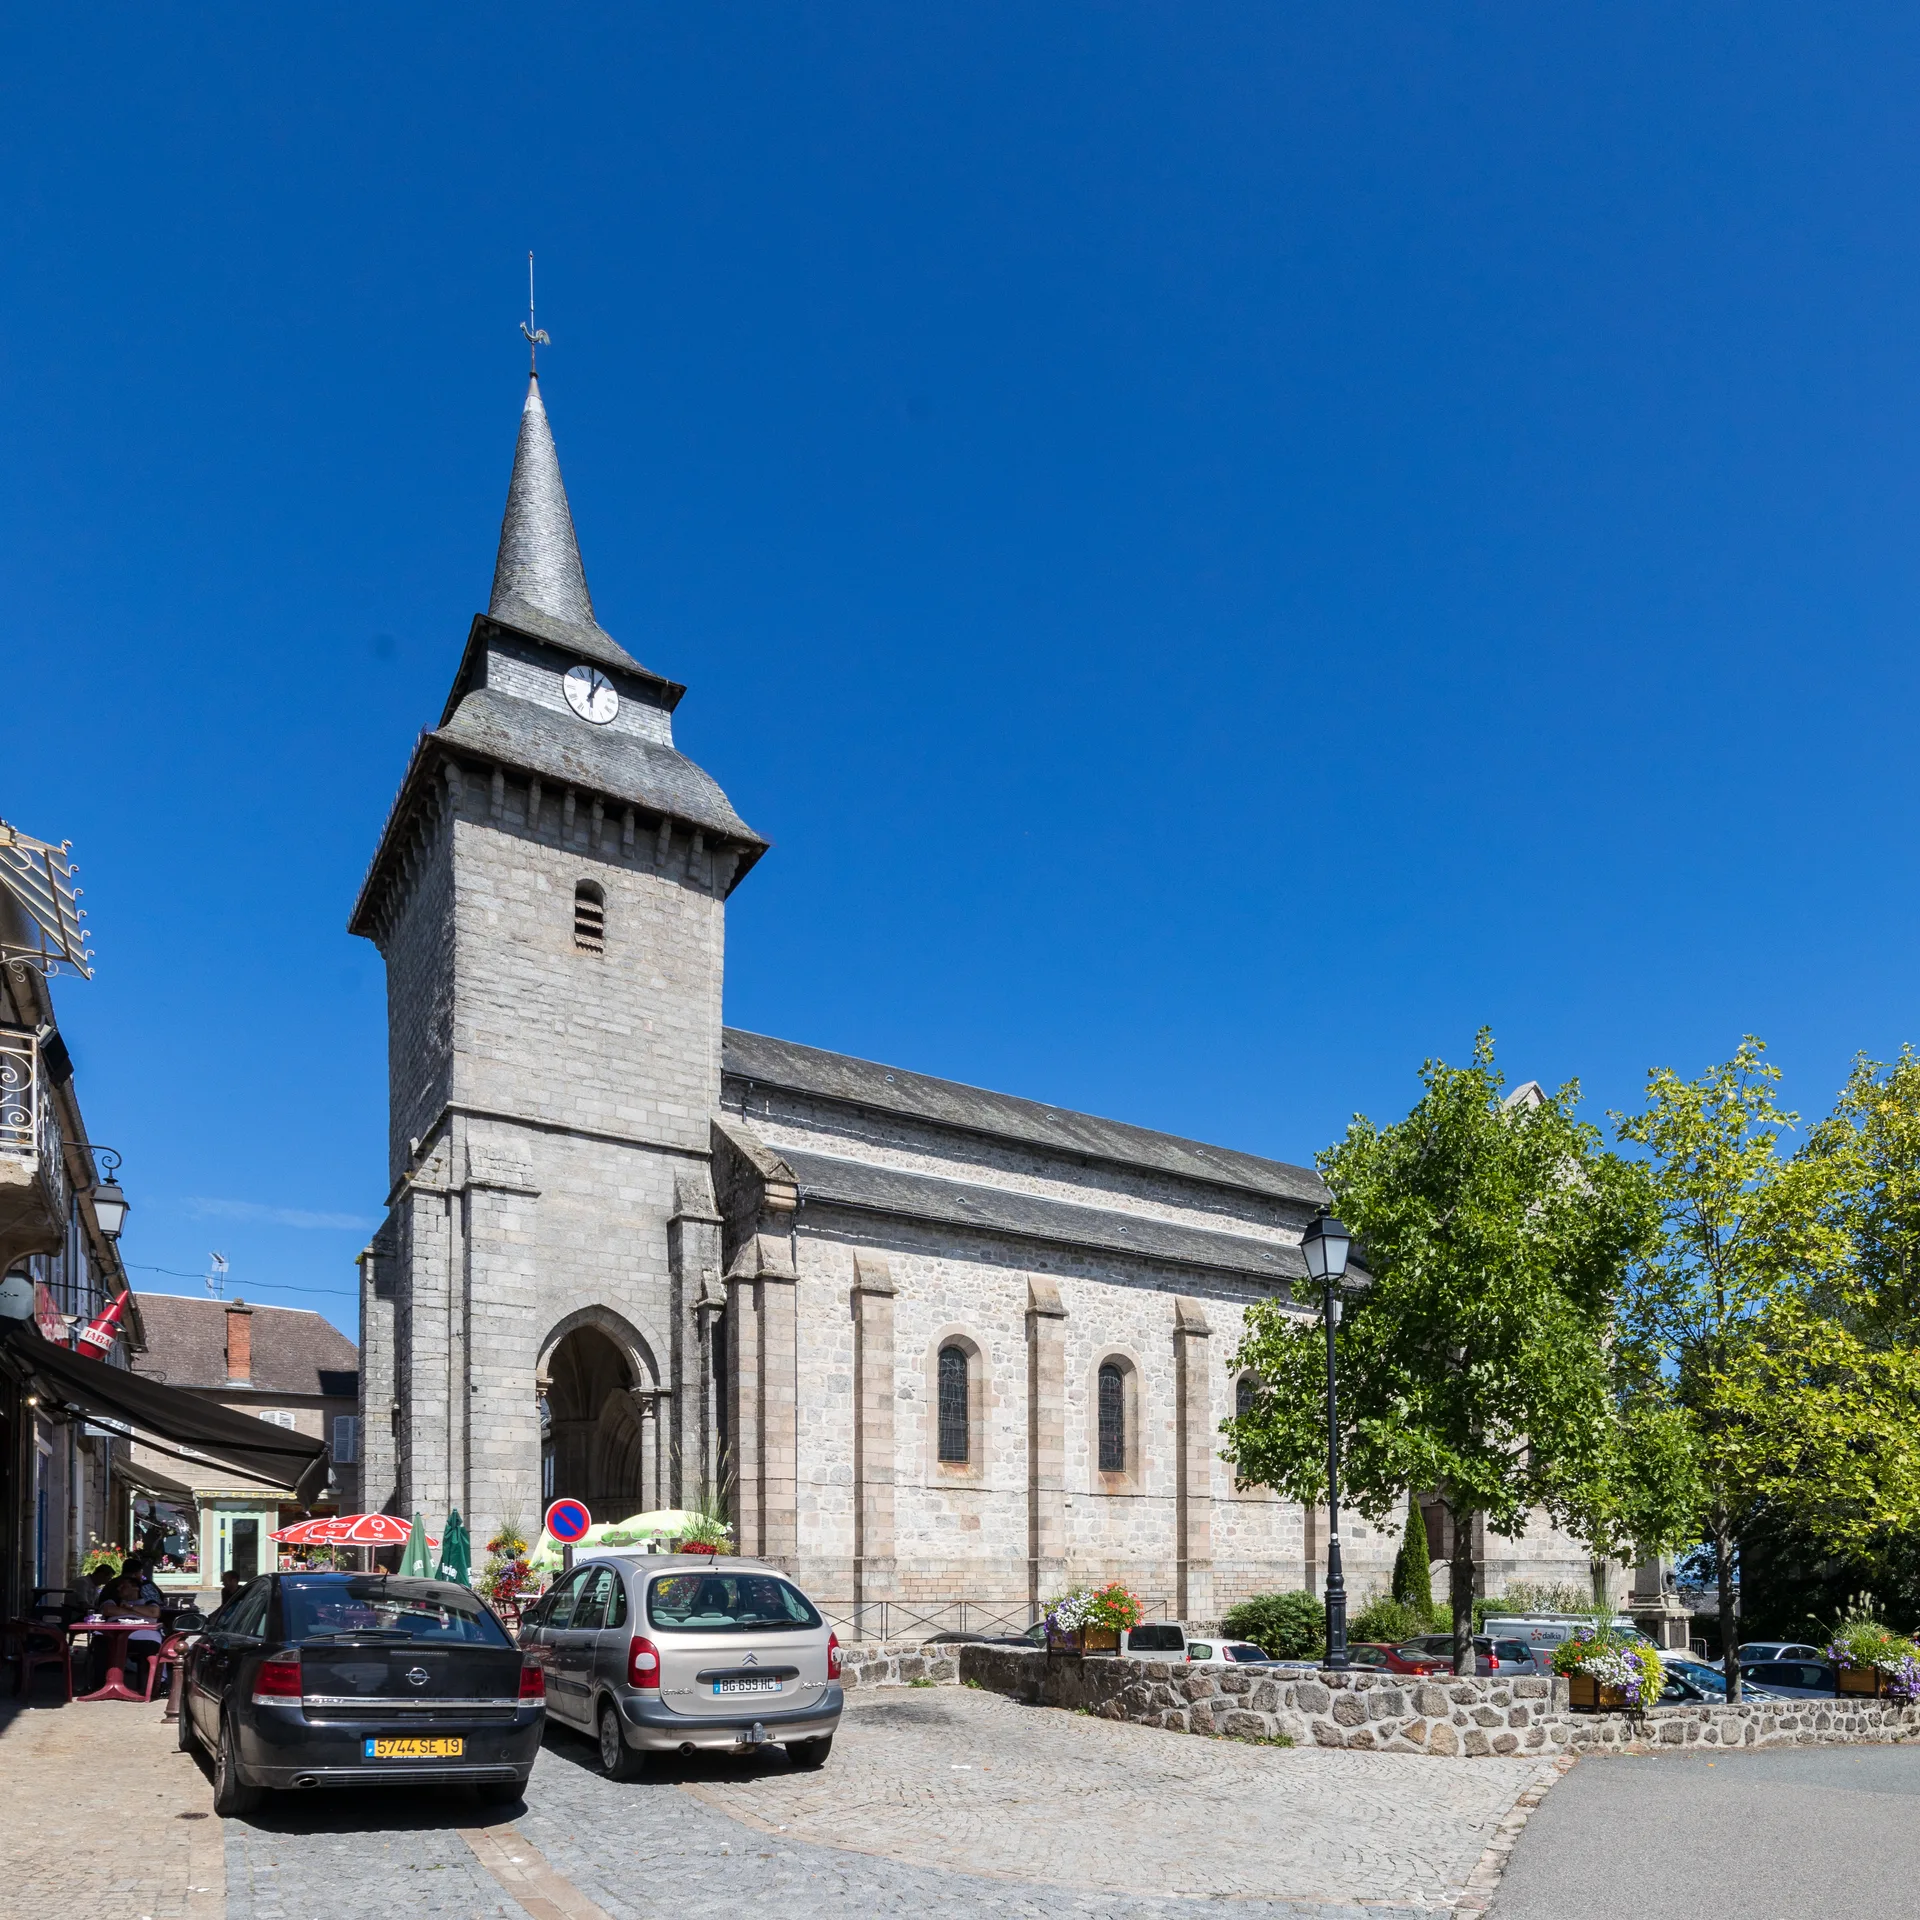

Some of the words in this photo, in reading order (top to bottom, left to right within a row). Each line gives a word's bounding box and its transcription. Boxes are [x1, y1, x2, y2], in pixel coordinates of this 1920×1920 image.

[722, 1678, 774, 1692] BG-699-HC
[377, 1740, 415, 1754] 5744
[419, 1740, 438, 1754] SE
[443, 1740, 460, 1753] 19
